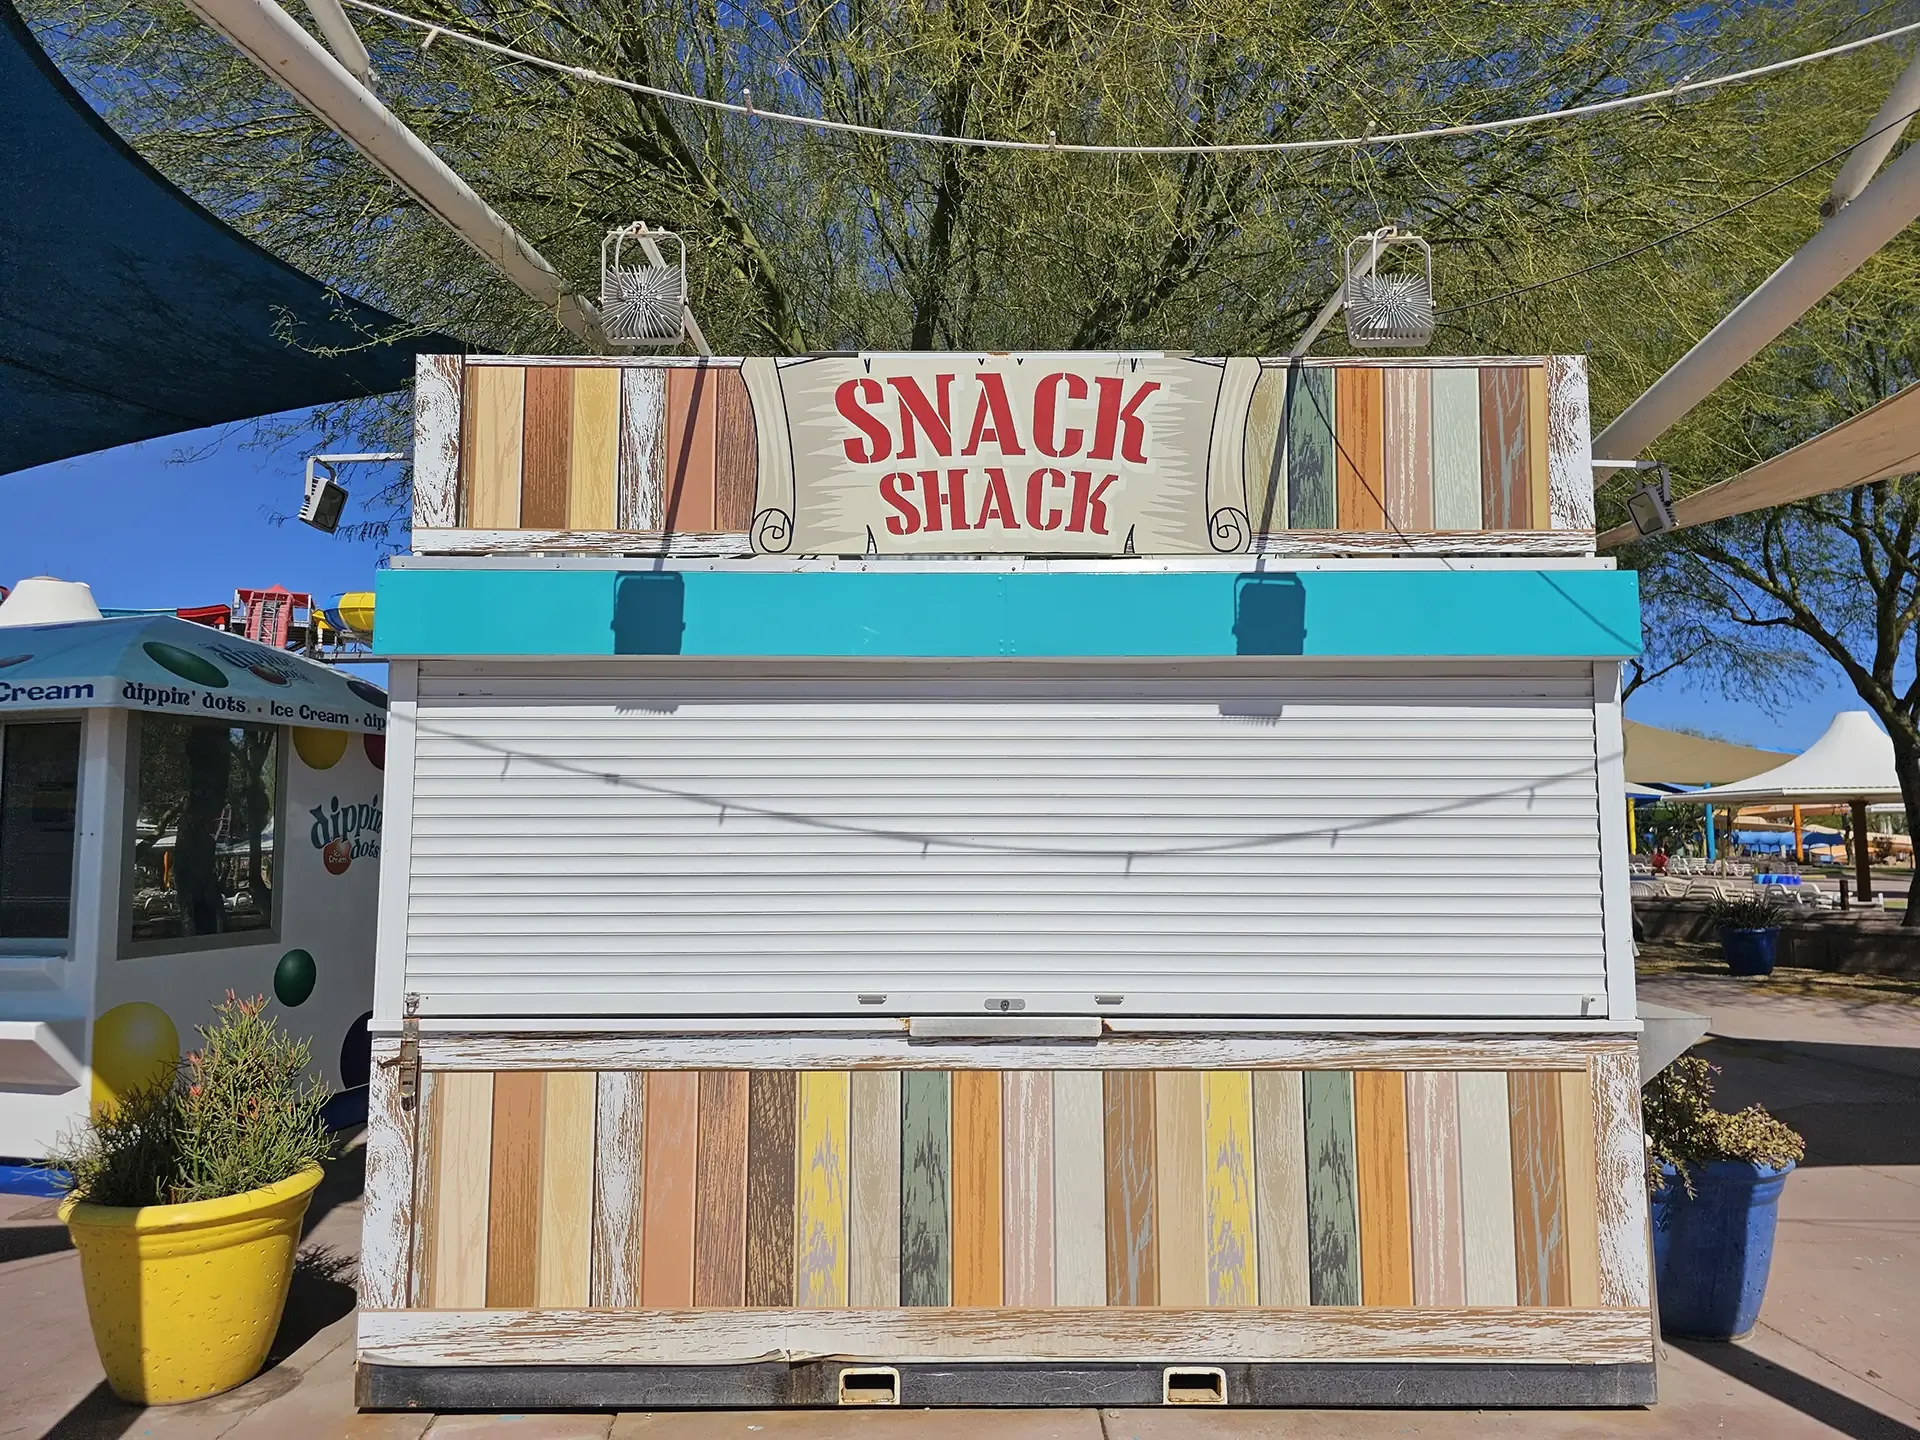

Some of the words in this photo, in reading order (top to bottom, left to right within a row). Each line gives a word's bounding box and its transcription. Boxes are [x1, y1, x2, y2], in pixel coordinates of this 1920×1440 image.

[834, 372, 1161, 464] SNACK
[879, 468, 1119, 535] SHACK
[0, 682, 94, 702] Cream
[122, 682, 196, 707] dippin'
[202, 691, 246, 713] dots
[270, 700, 294, 718] Ice
[299, 704, 349, 725] Cream
[350, 838, 380, 860] dots
